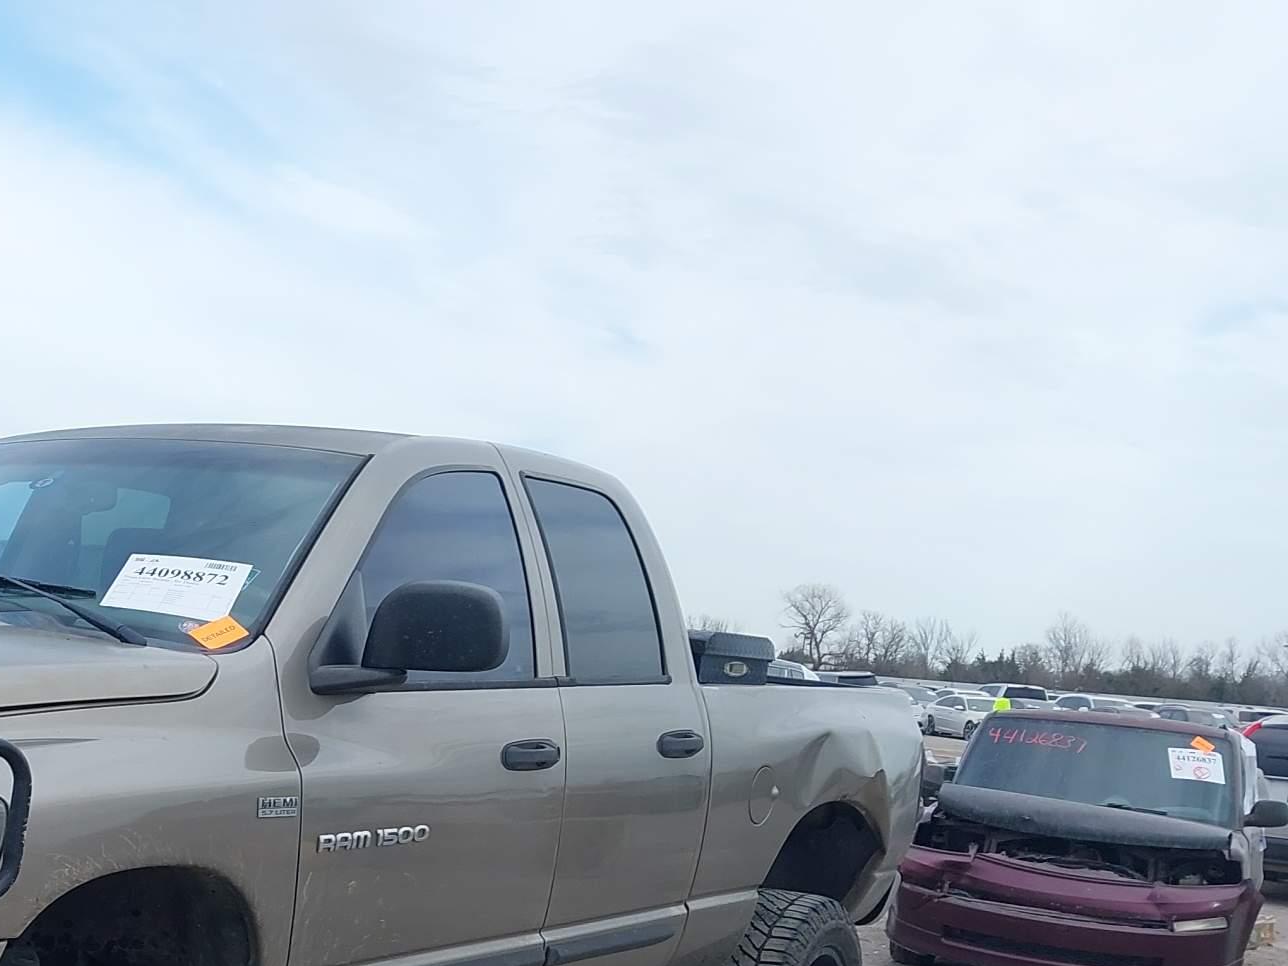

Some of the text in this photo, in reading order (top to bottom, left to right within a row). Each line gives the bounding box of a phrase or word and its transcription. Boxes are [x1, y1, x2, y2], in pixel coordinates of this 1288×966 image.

[134, 566, 230, 587] 44098872
[200, 624, 237, 644] DETAILED
[988, 727, 1089, 754] 44126837
[261, 798, 298, 809] HEMI
[318, 824, 431, 853] RAM 1500
